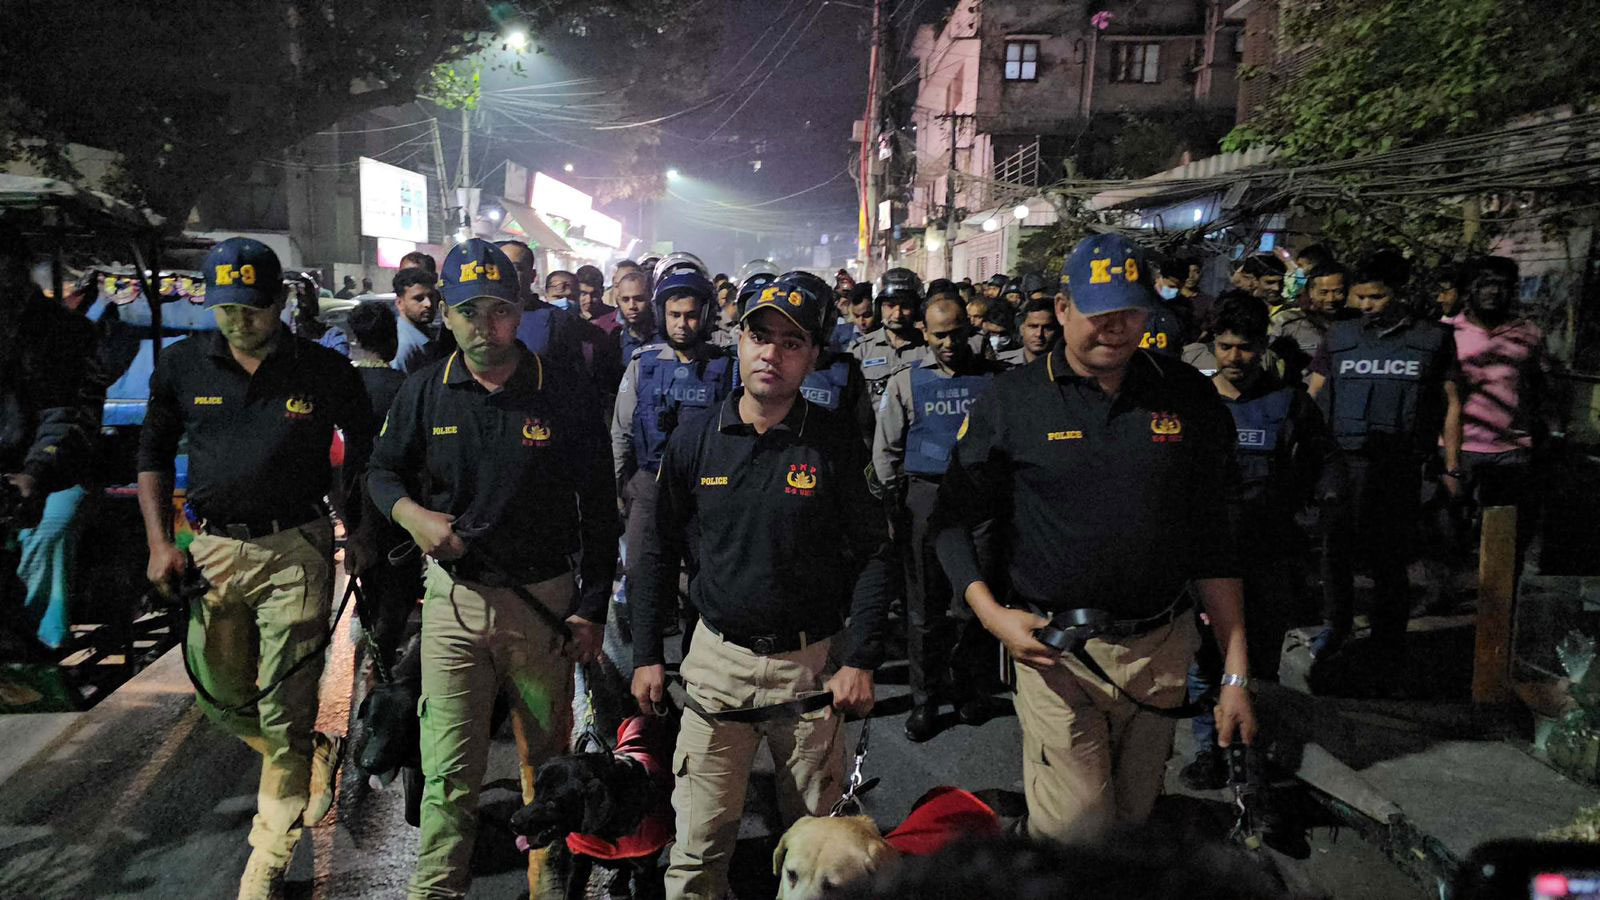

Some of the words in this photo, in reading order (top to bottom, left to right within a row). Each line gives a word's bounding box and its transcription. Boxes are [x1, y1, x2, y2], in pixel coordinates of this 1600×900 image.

[215, 264, 256, 286] K-9
[459, 260, 501, 283] K-9
[1089, 257, 1139, 284] K-9
[757, 286, 803, 307] K-9
[1339, 359, 1420, 376] POLICE
[924, 398, 977, 416] POLIC
[432, 426, 458, 435] POLICE
[1047, 430, 1083, 441] POLICE
[700, 476, 728, 486] POLICE
